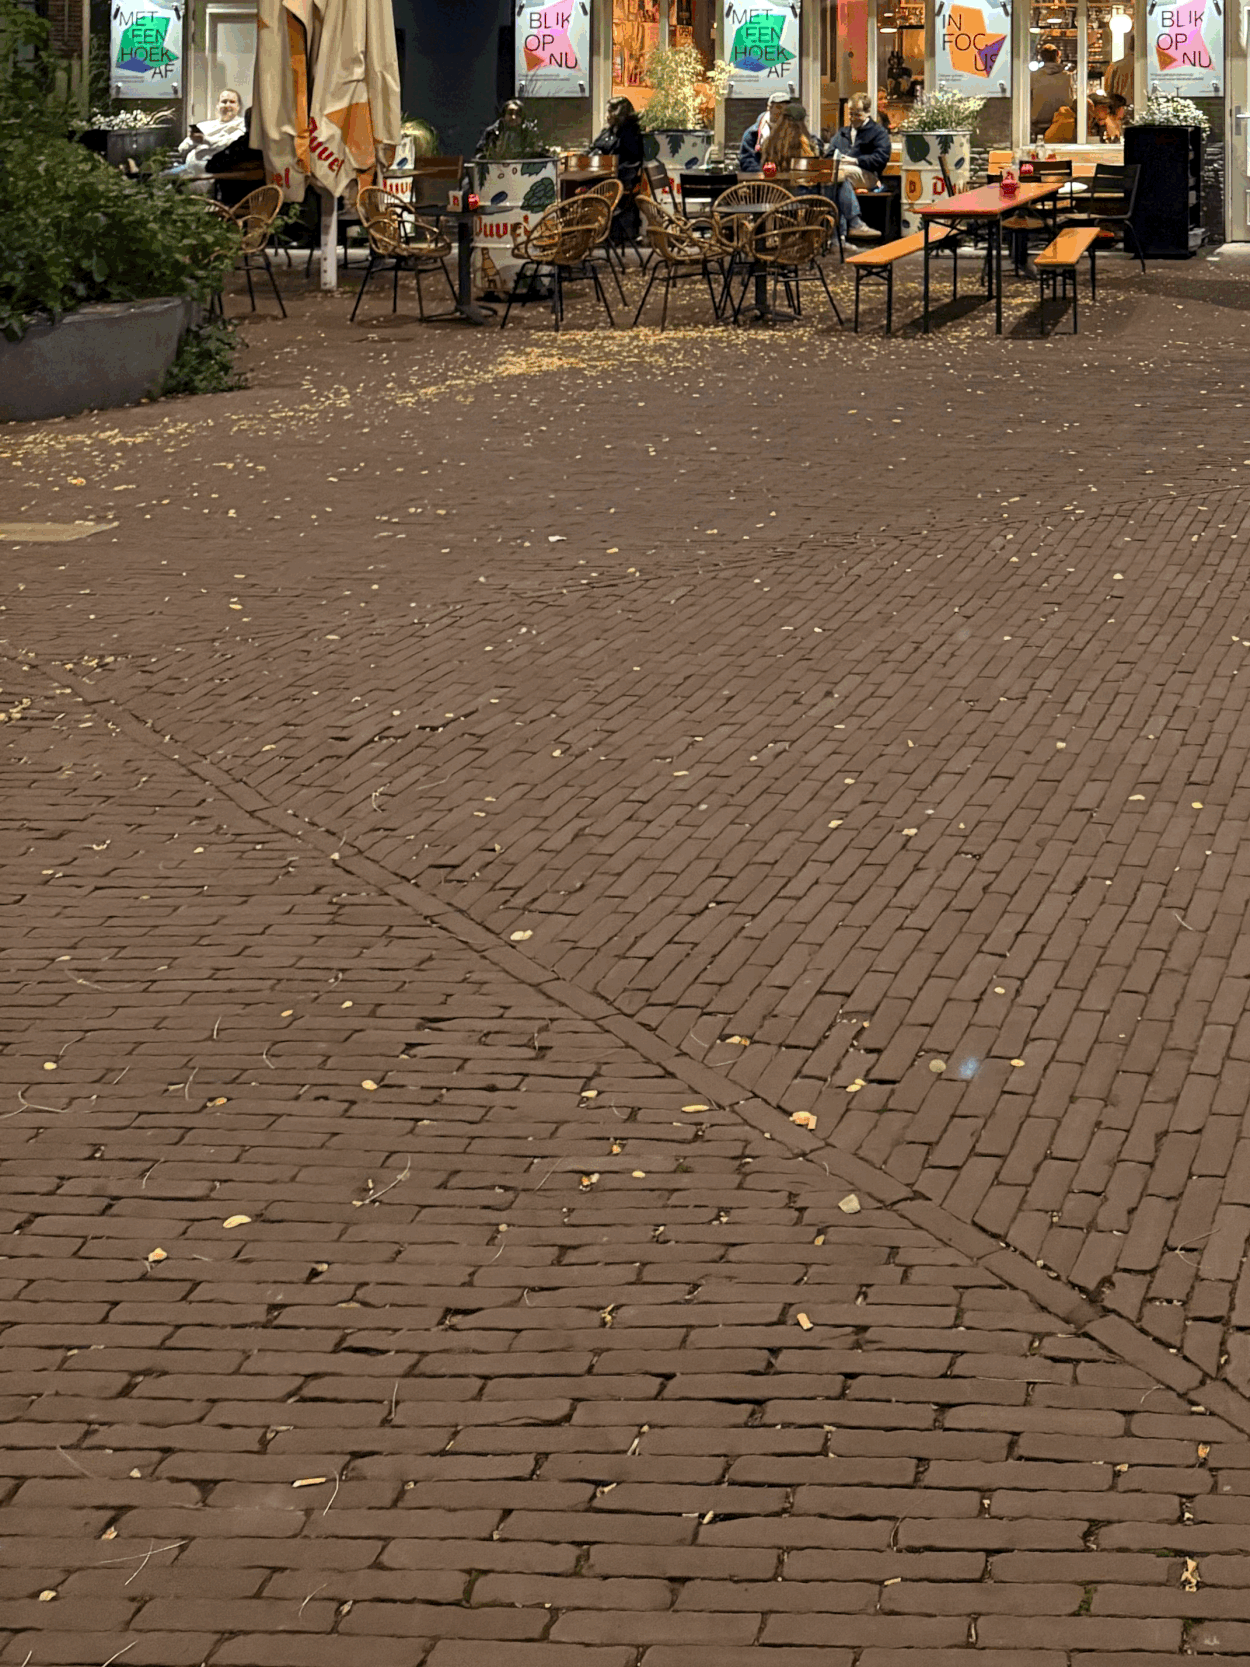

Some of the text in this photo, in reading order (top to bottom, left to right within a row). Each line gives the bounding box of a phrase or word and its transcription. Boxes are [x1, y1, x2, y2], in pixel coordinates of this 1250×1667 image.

[119, 11, 158, 26] MET
[529, 11, 571, 29] BLIK
[732, 9, 773, 24] MET
[942, 14, 961, 31] IN
[1161, 10, 1205, 27] BLIK
[524, 34, 554, 52] OP
[942, 33, 987, 51] FOC
[1156, 33, 1188, 51] OP
[121, 46, 172, 62] HOEK
[549, 52, 578, 69] NU
[734, 45, 789, 61] HOEK
[1182, 50, 1212, 68] NU
[151, 63, 175, 78] AF
[767, 62, 791, 78] AF
